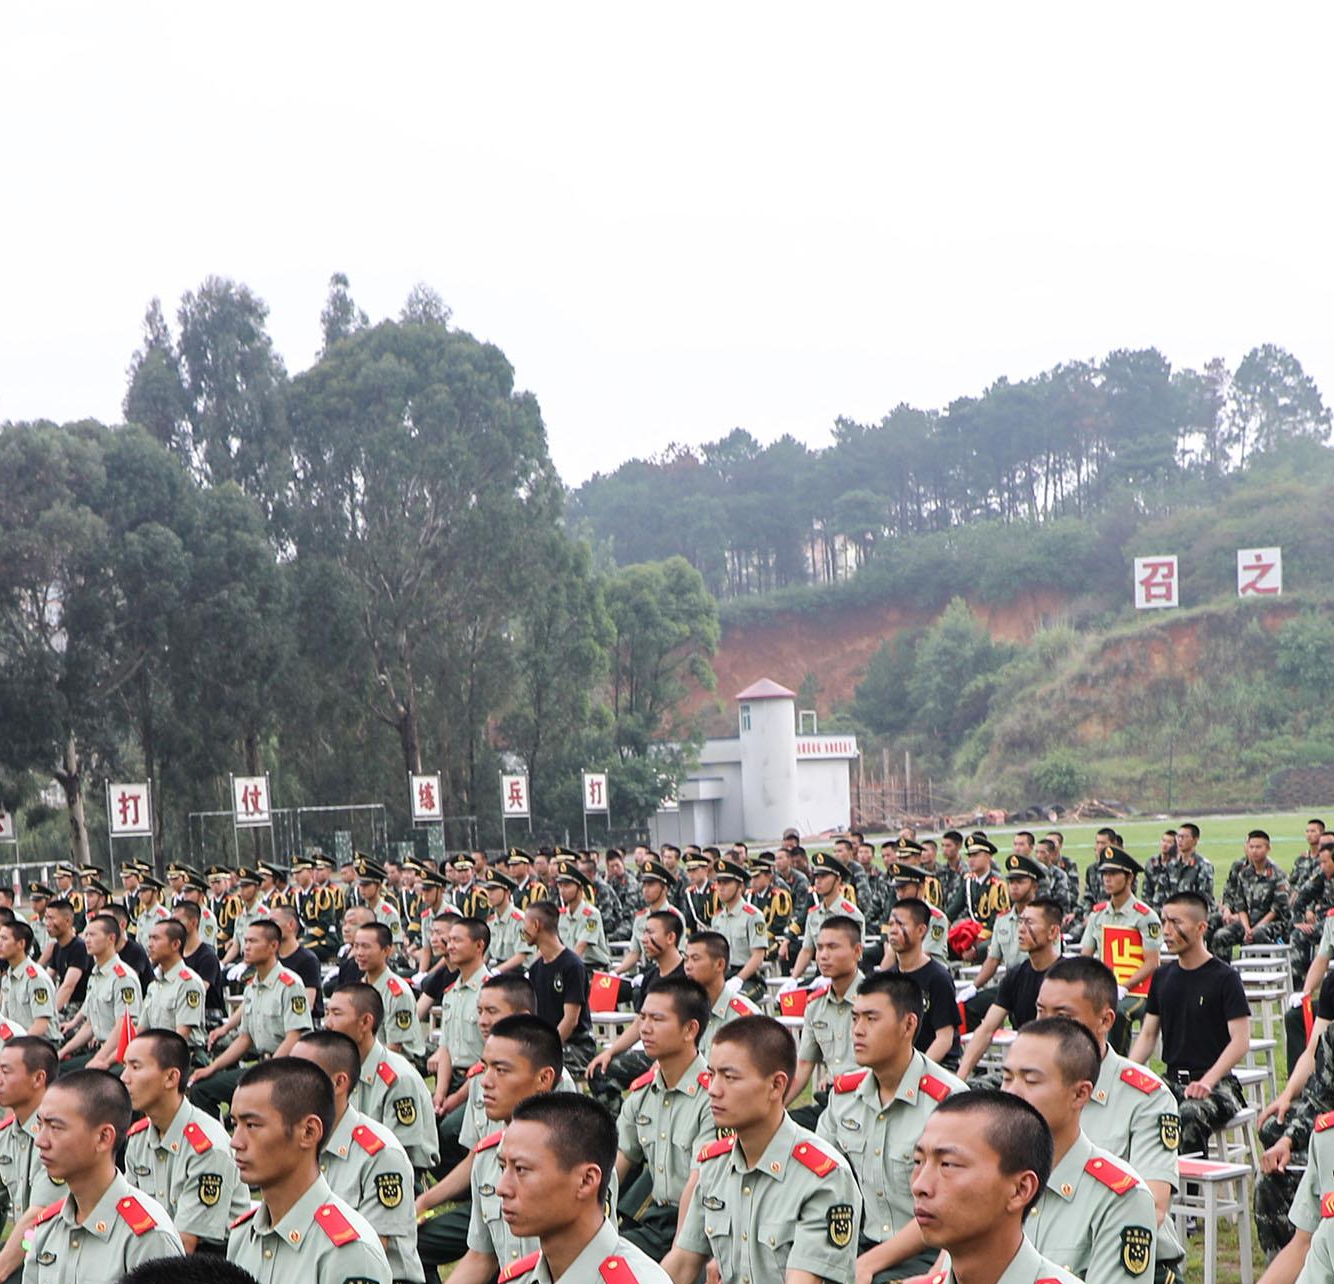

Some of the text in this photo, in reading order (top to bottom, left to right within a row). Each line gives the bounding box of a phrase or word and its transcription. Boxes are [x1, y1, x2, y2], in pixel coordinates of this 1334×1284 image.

[1141, 561, 1176, 601] 召
[1240, 554, 1278, 595] 之
[118, 792, 141, 825] 打
[242, 785, 262, 816] 仗
[508, 780, 523, 808] 兵
[589, 779, 603, 805] 打
